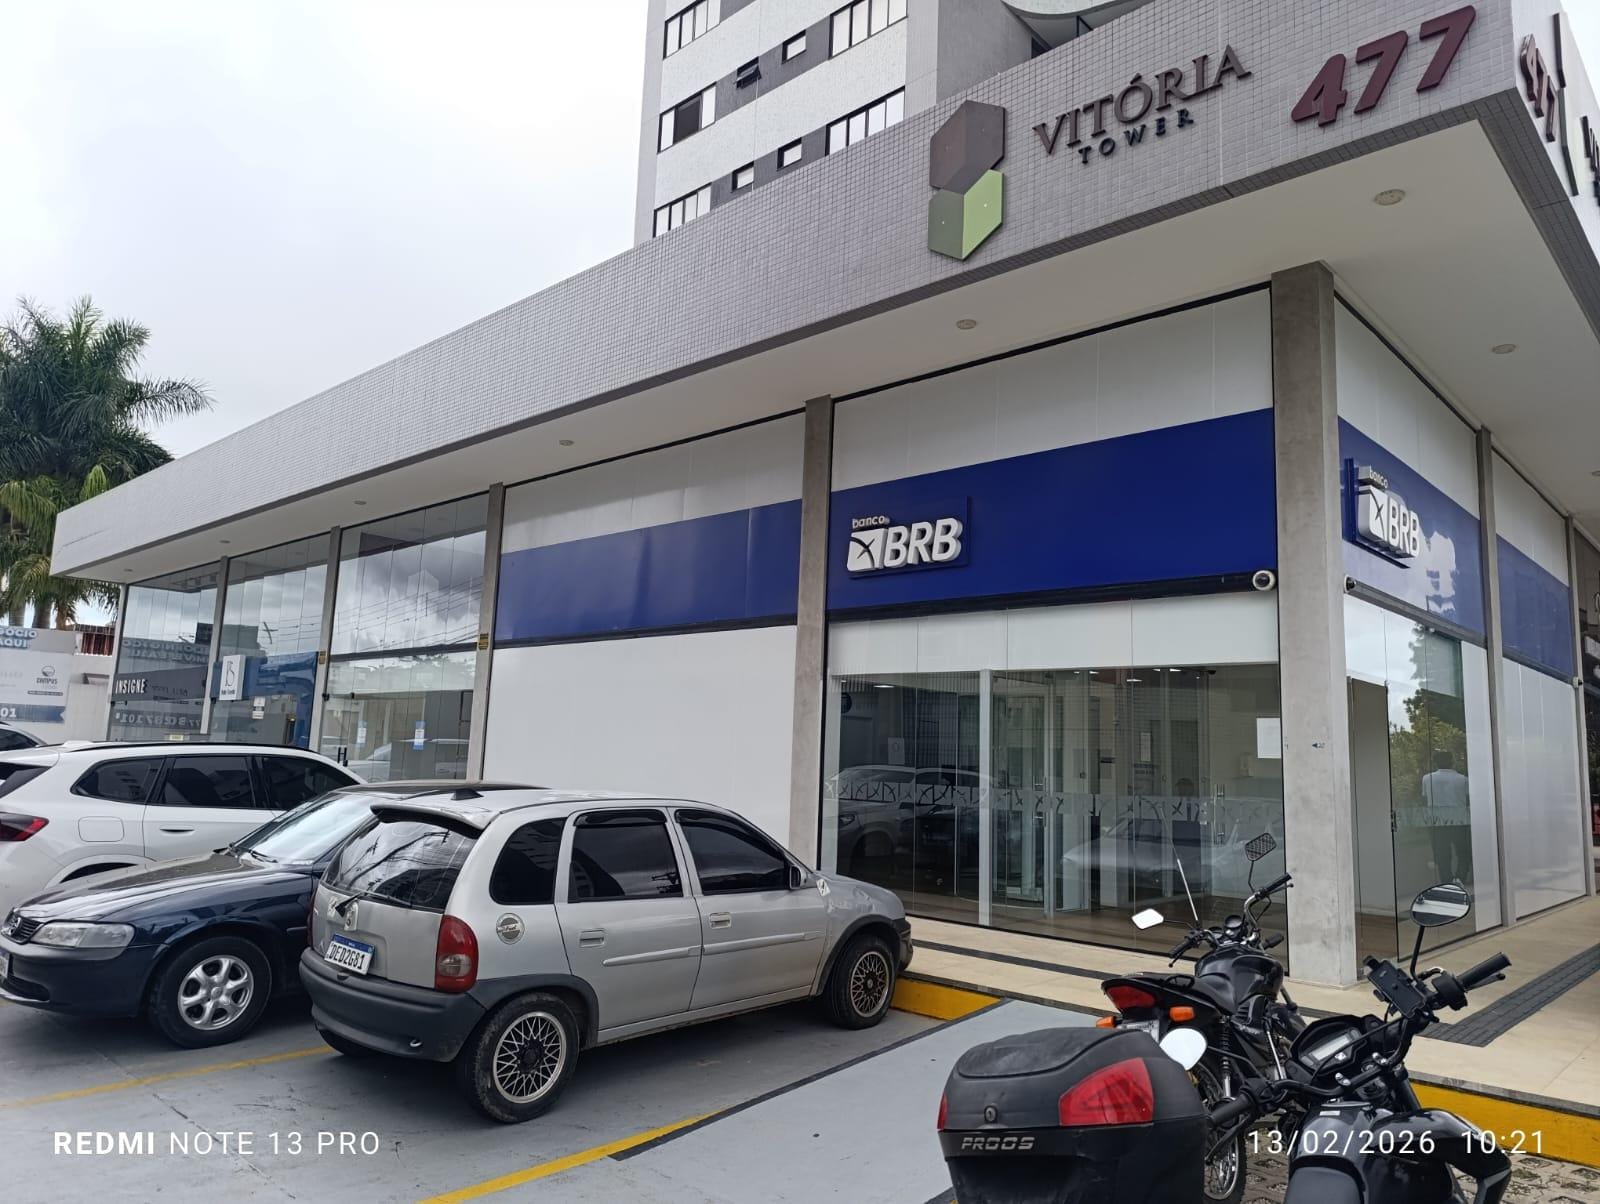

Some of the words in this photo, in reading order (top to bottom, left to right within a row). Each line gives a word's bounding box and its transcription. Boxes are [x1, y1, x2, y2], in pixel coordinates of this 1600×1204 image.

[1291, 5, 1476, 127] 477
[1032, 44, 1252, 155] VITÓRIA
[1078, 108, 1194, 164] TOWER
[852, 516, 885, 529] banco
[884, 517, 963, 568] BRB
[1388, 497, 1420, 558] BRB
[115, 679, 147, 694] INSIGNE
[328, 944, 366, 970] DED2G81
[961, 1137, 1035, 1150] PROOS
